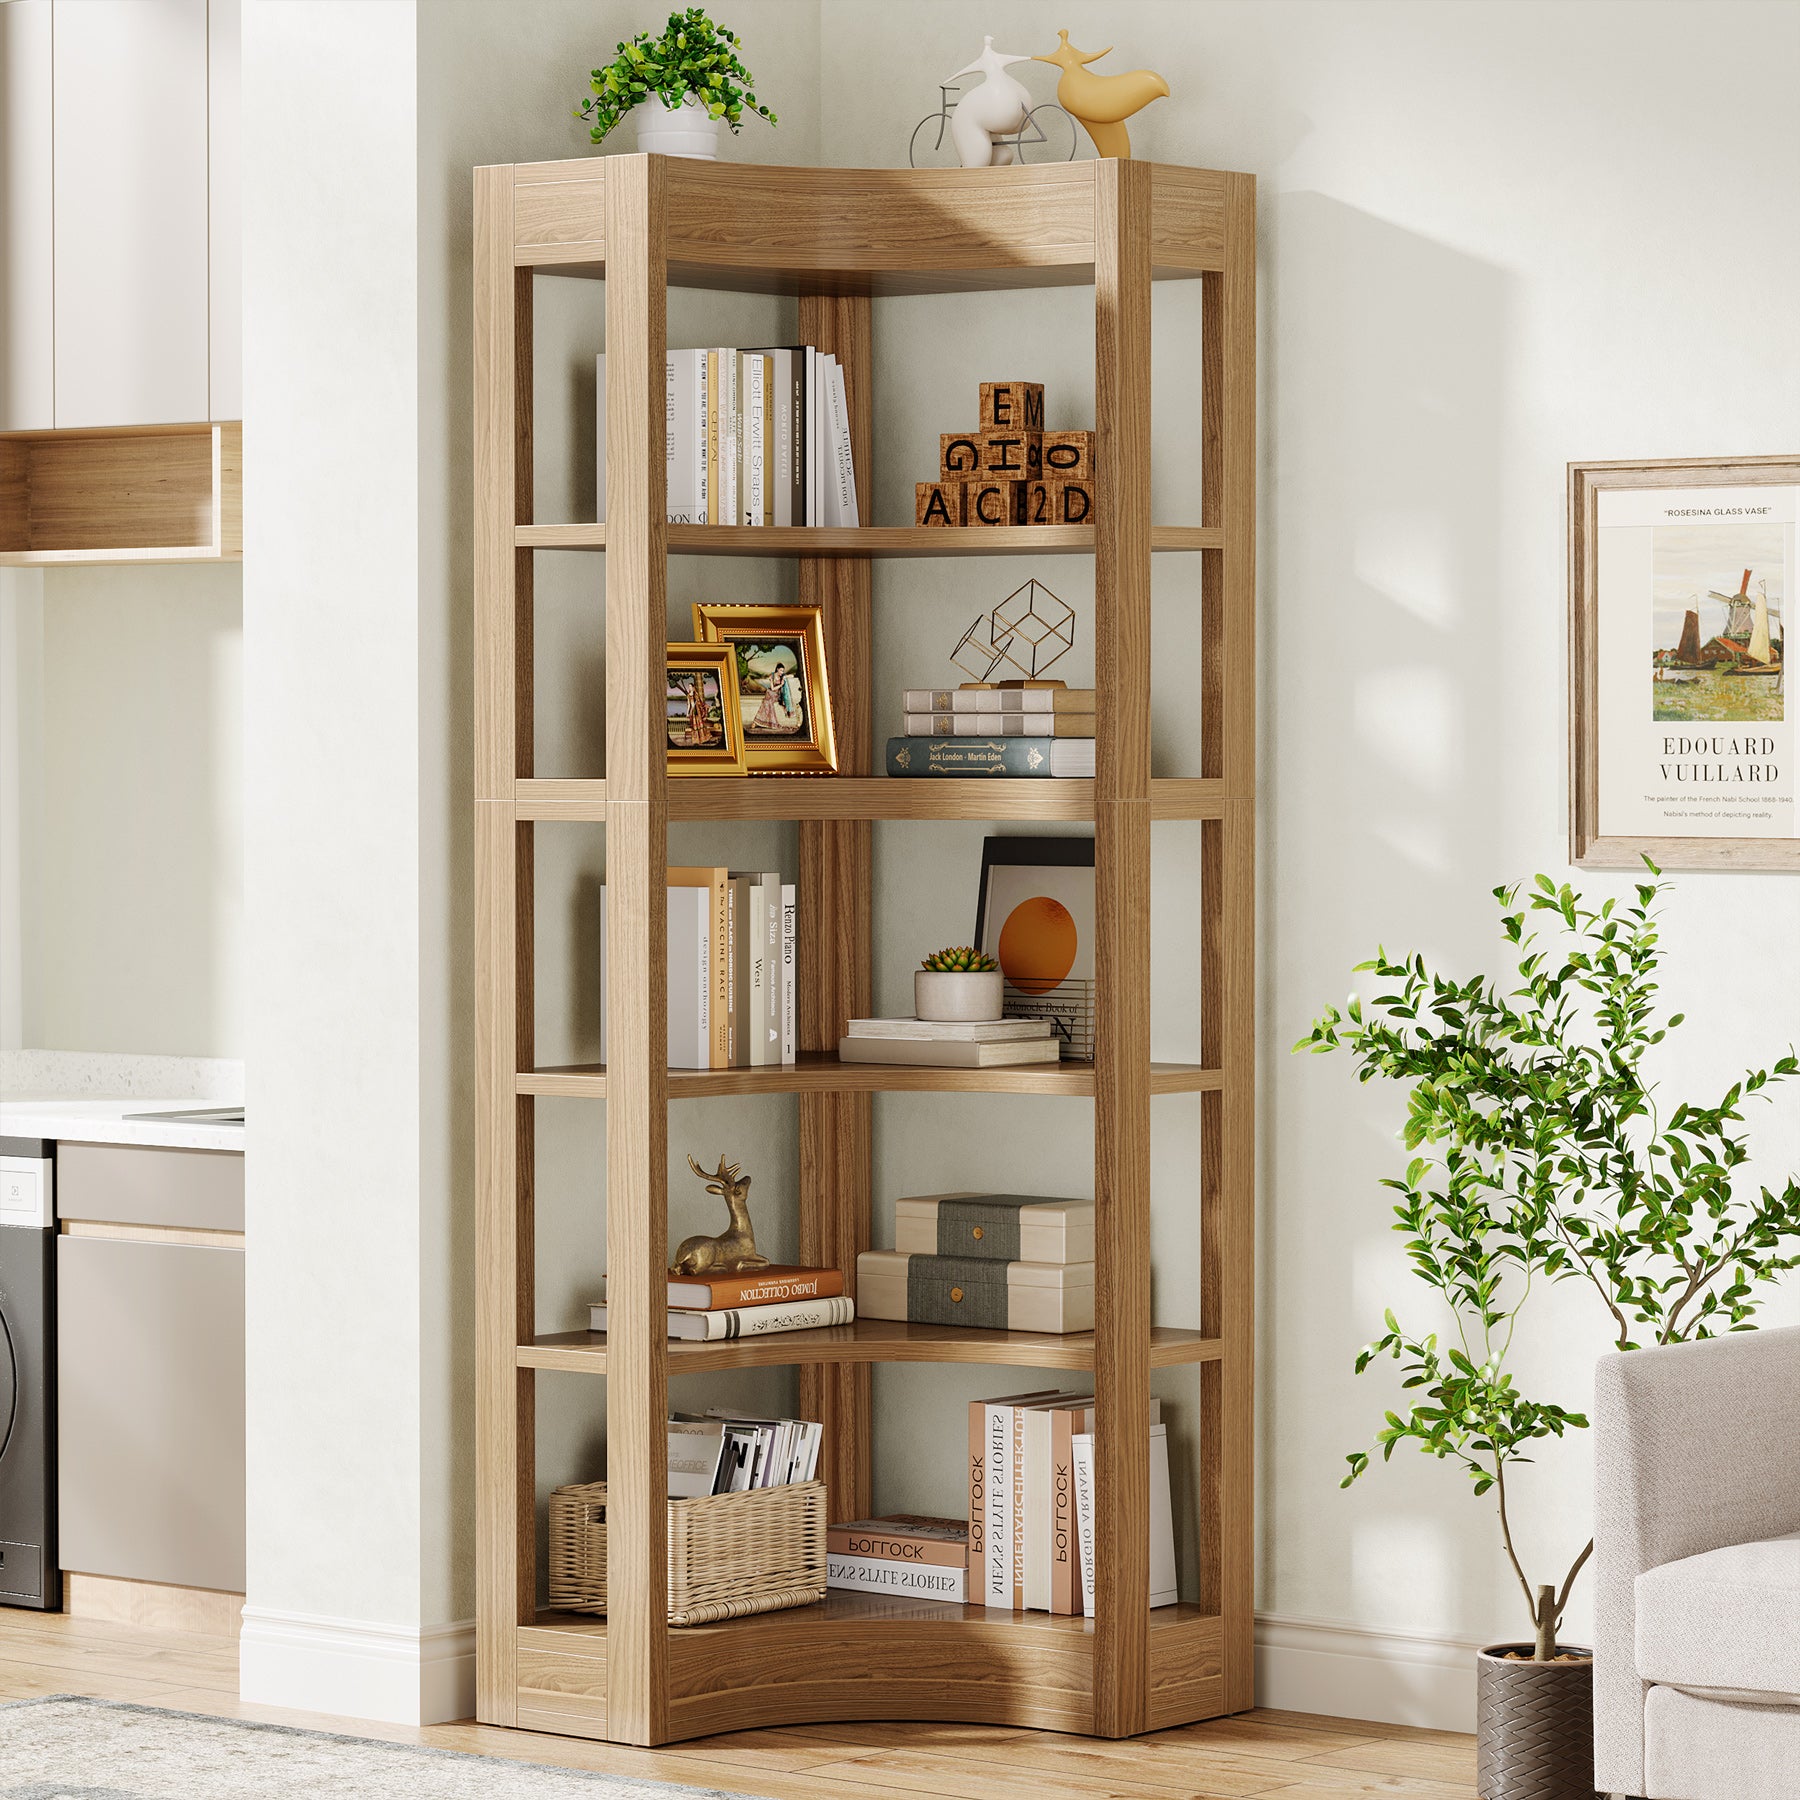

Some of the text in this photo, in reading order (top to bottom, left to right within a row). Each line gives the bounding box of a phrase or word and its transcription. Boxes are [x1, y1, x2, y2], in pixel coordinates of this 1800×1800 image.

[994, 388, 1010, 424] E
[1026, 390, 1043, 427] M
[752, 359, 762, 507] Elliott Erwitt Snaps
[923, 489, 952, 525] A
[976, 488, 1000, 524] C
[1034, 486, 1046, 523] 2
[1064, 486, 1090, 523] D
[1714, 508, 1743, 516] GLASS
[1745, 507, 1772, 515] VASE"
[930, 753, 941, 761] Jack
[942, 753, 963, 761] London
[968, 753, 987, 761] Martin
[988, 753, 1002, 761] Eden
[1664, 737, 1774, 755] EDOUARD
[1660, 764, 1779, 782] VUILLARD
[784, 905, 795, 965] Renzo Piano
[755, 958, 763, 988] West
[1069, 1004, 1079, 1014] of
[741, 1286, 790, 1301] COLLECTION
